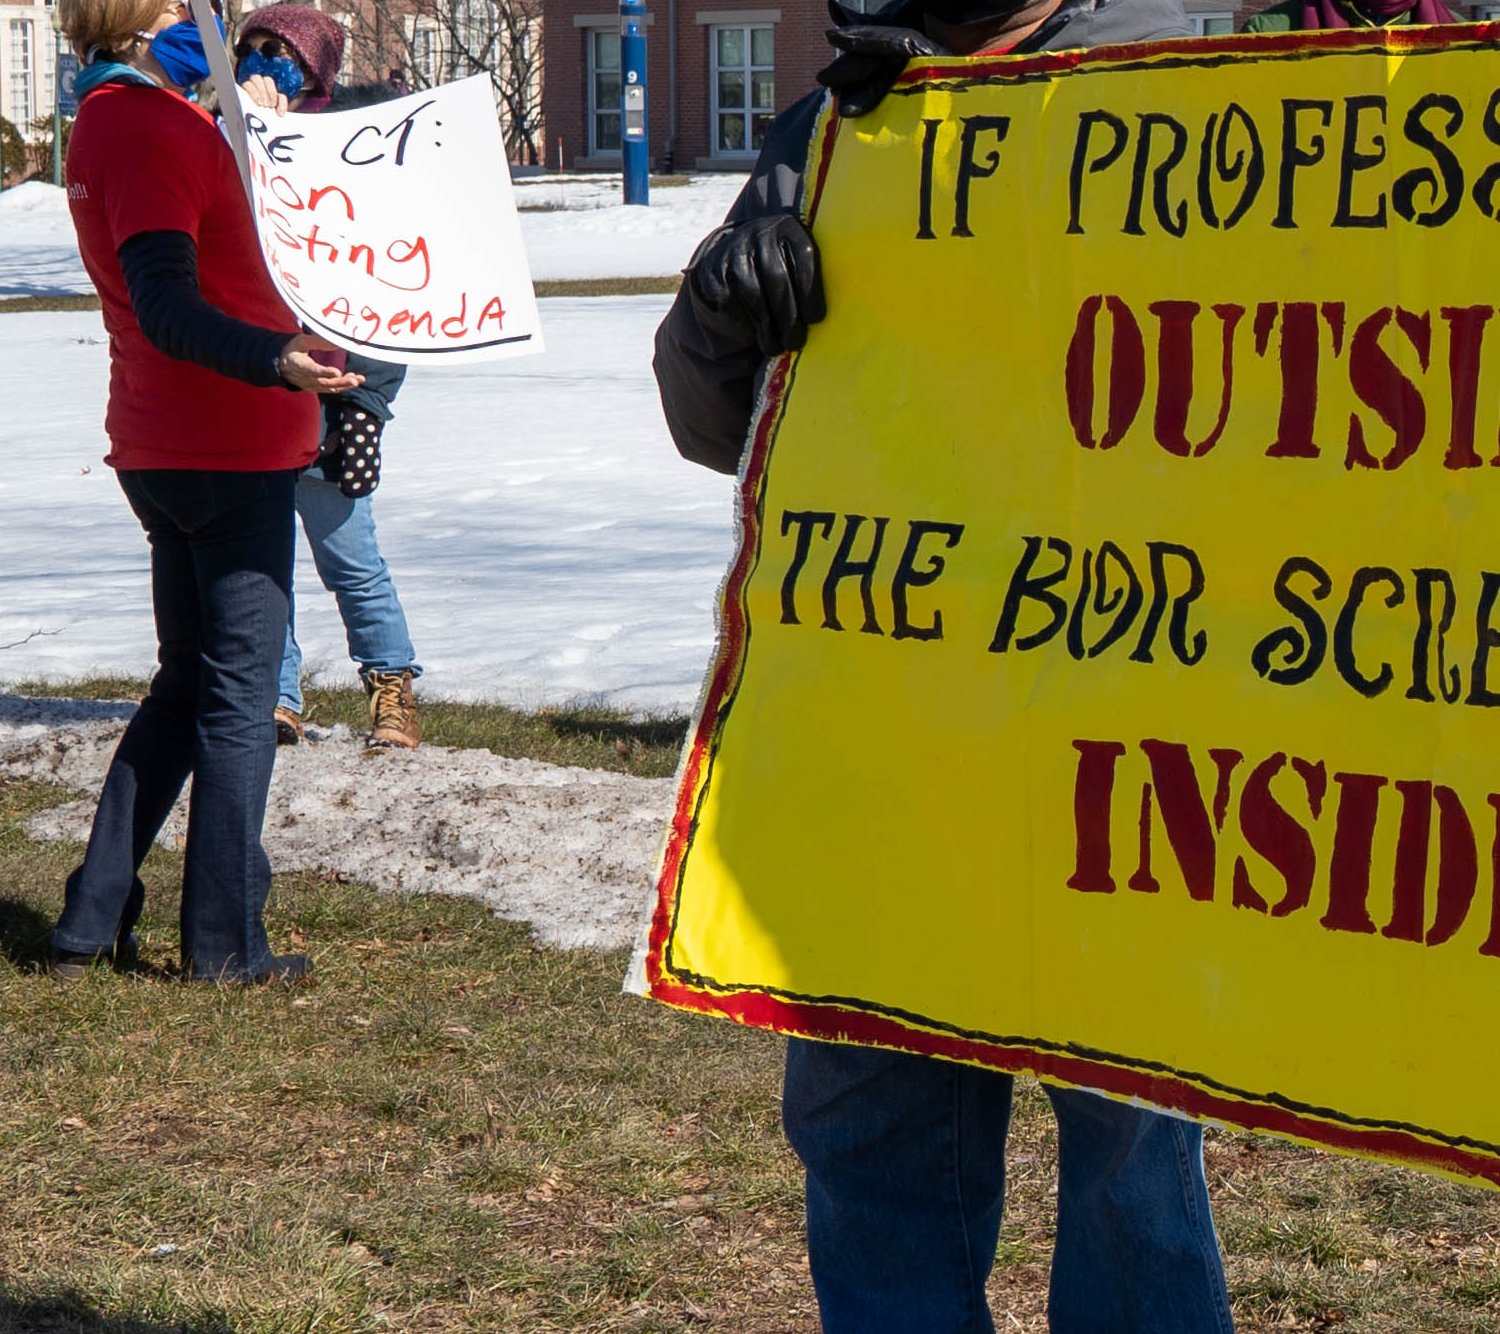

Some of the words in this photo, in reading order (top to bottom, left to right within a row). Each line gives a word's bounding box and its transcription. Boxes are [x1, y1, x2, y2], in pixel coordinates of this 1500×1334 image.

[627, 70, 638, 84] 9
[915, 115, 1010, 240] IF
[779, 510, 965, 642] THE
[988, 534, 1208, 667] BOR
